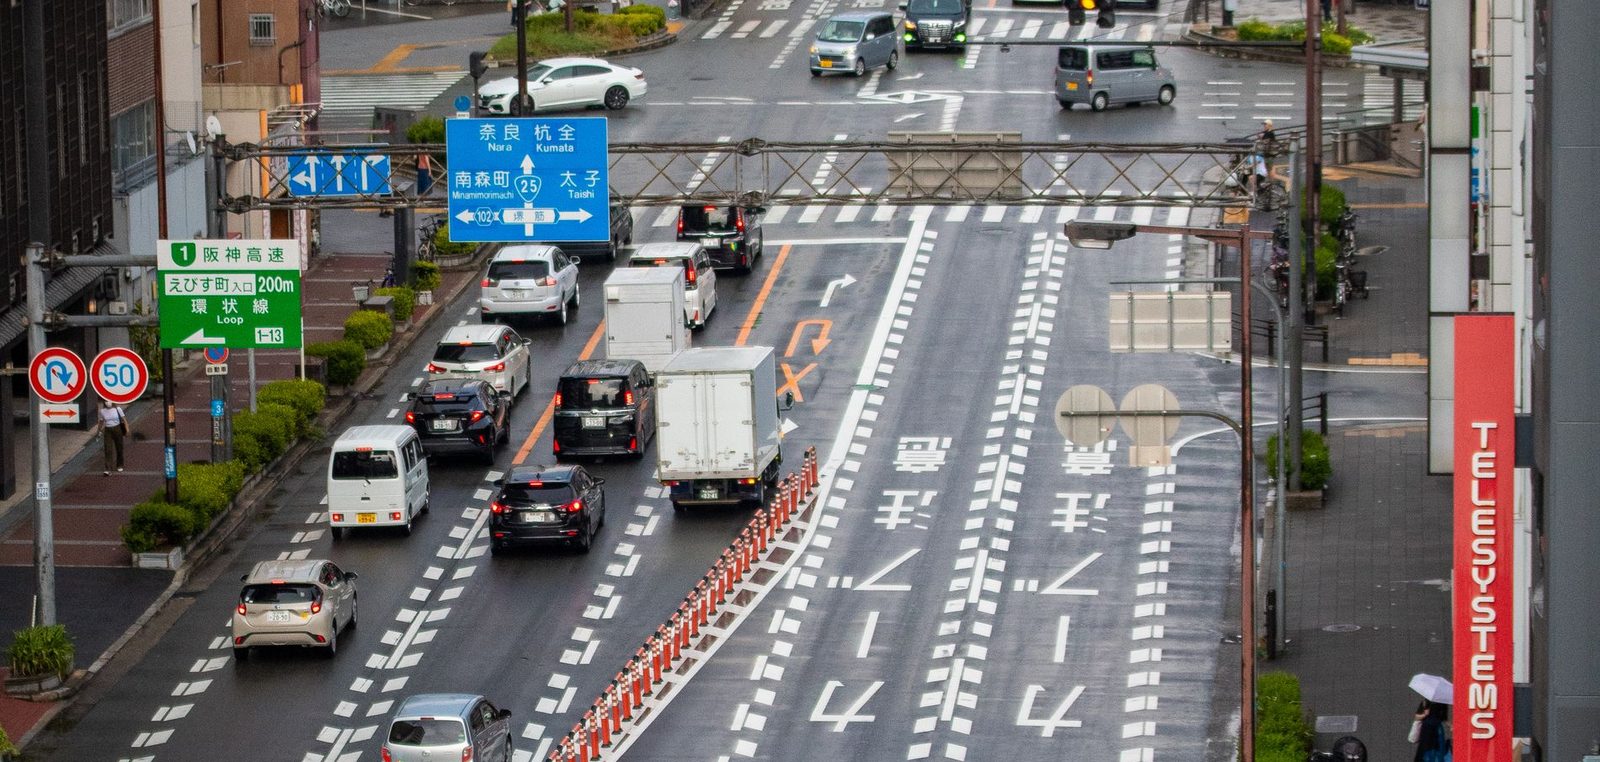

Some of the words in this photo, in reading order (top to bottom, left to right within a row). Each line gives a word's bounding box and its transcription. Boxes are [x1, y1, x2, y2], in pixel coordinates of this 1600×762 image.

[480, 123, 520, 141] 奈良
[534, 124, 576, 141] 杭全
[488, 142, 513, 152] Nara
[536, 143, 574, 152] Kumata
[455, 170, 510, 188] 南森町
[520, 179, 538, 193] 25
[559, 170, 601, 187] 太子
[452, 191, 514, 200] Minamimorimachi
[568, 189, 595, 199] Taishi
[477, 211, 491, 222] 102
[180, 245, 188, 261] 1
[203, 247, 285, 263] 阪神高速
[258, 276, 294, 293] 200m
[191, 298, 269, 314] 環状線
[217, 315, 244, 325] Loop
[257, 329, 282, 342] 1-13
[103, 364, 134, 388] 50
[1468, 422, 1497, 739] TELESYSTEMS
